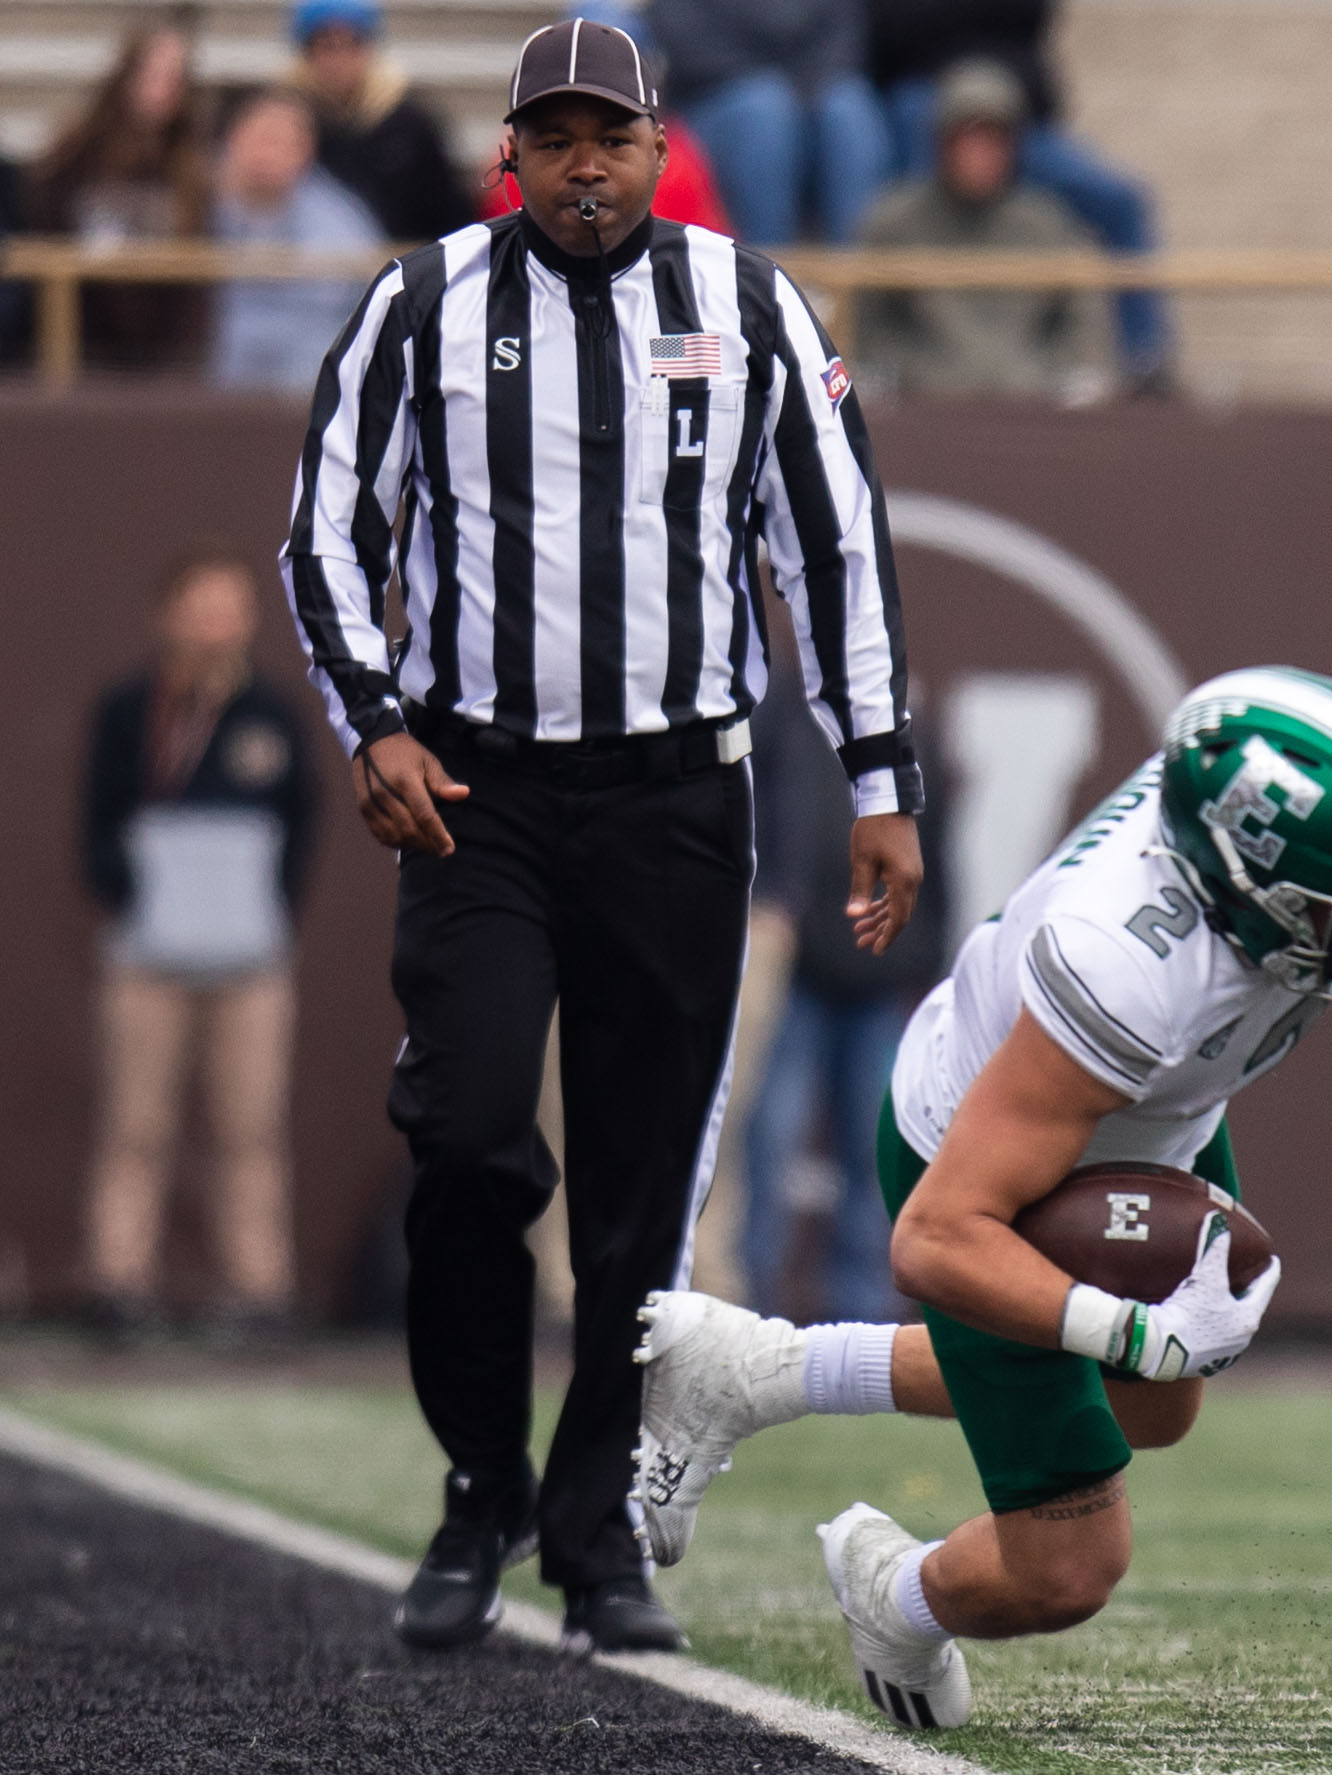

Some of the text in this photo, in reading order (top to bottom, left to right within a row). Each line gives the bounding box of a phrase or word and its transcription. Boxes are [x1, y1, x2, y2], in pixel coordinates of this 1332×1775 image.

[492, 336, 521, 371] S
[675, 408, 704, 457] L
[1198, 733, 1326, 871] E
[1124, 886, 1199, 960] 2
[1104, 1192, 1151, 1242] E
